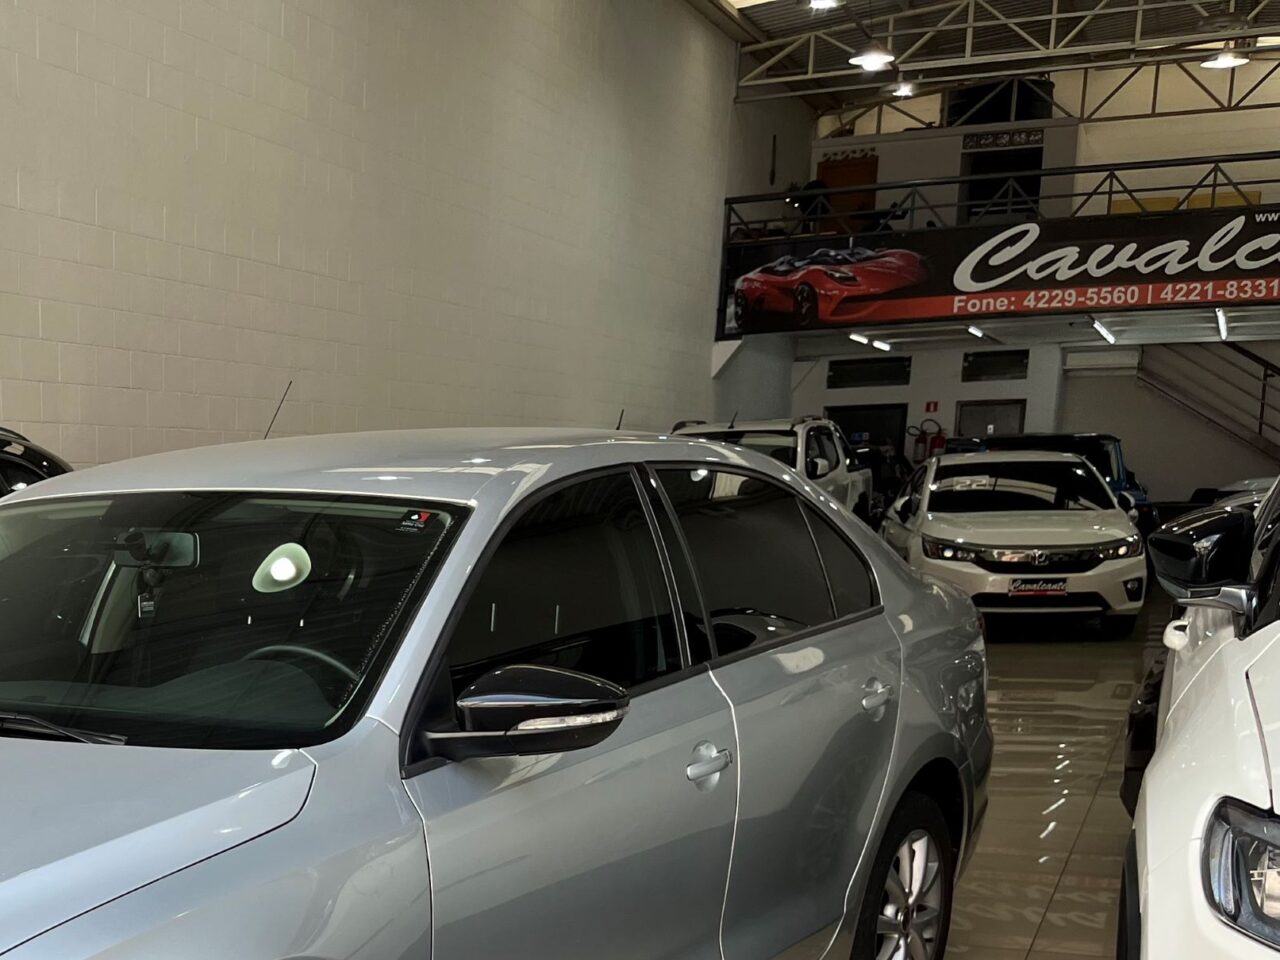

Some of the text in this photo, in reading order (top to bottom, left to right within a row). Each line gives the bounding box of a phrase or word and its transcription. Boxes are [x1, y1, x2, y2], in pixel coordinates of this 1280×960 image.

[1255, 212, 1280, 222] ww
[953, 215, 1280, 292] Cavalc
[953, 296, 1015, 313] Fone:
[1023, 286, 1139, 309] 4229-5560
[1160, 279, 1280, 301] 4221-8331
